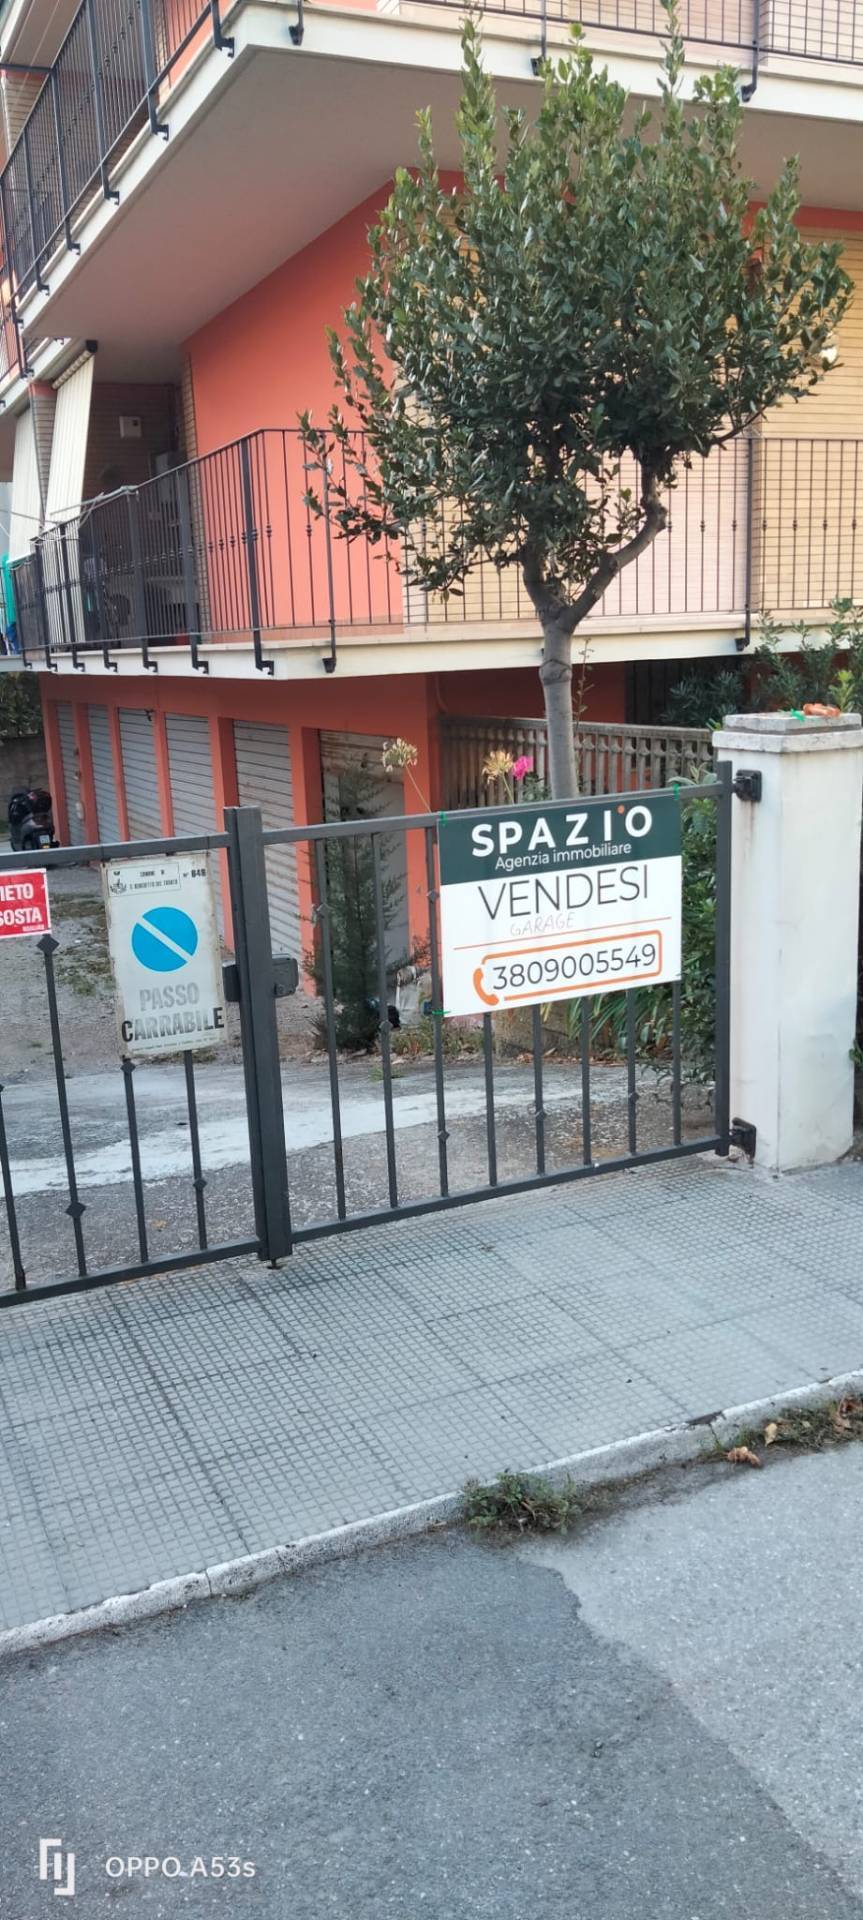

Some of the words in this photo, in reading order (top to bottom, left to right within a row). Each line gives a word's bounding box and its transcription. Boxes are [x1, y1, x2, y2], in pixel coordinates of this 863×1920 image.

[495, 852, 550, 872] Agenzia
[552, 842, 632, 864] immobiliare
[0, 883, 34, 901] IETO
[477, 863, 649, 921] VENDESI
[510, 911, 576, 937] GARAGE
[492, 943, 656, 990] 3809005549
[139, 982, 200, 1011] PASSO
[121, 1007, 225, 1042] CARRABILE
